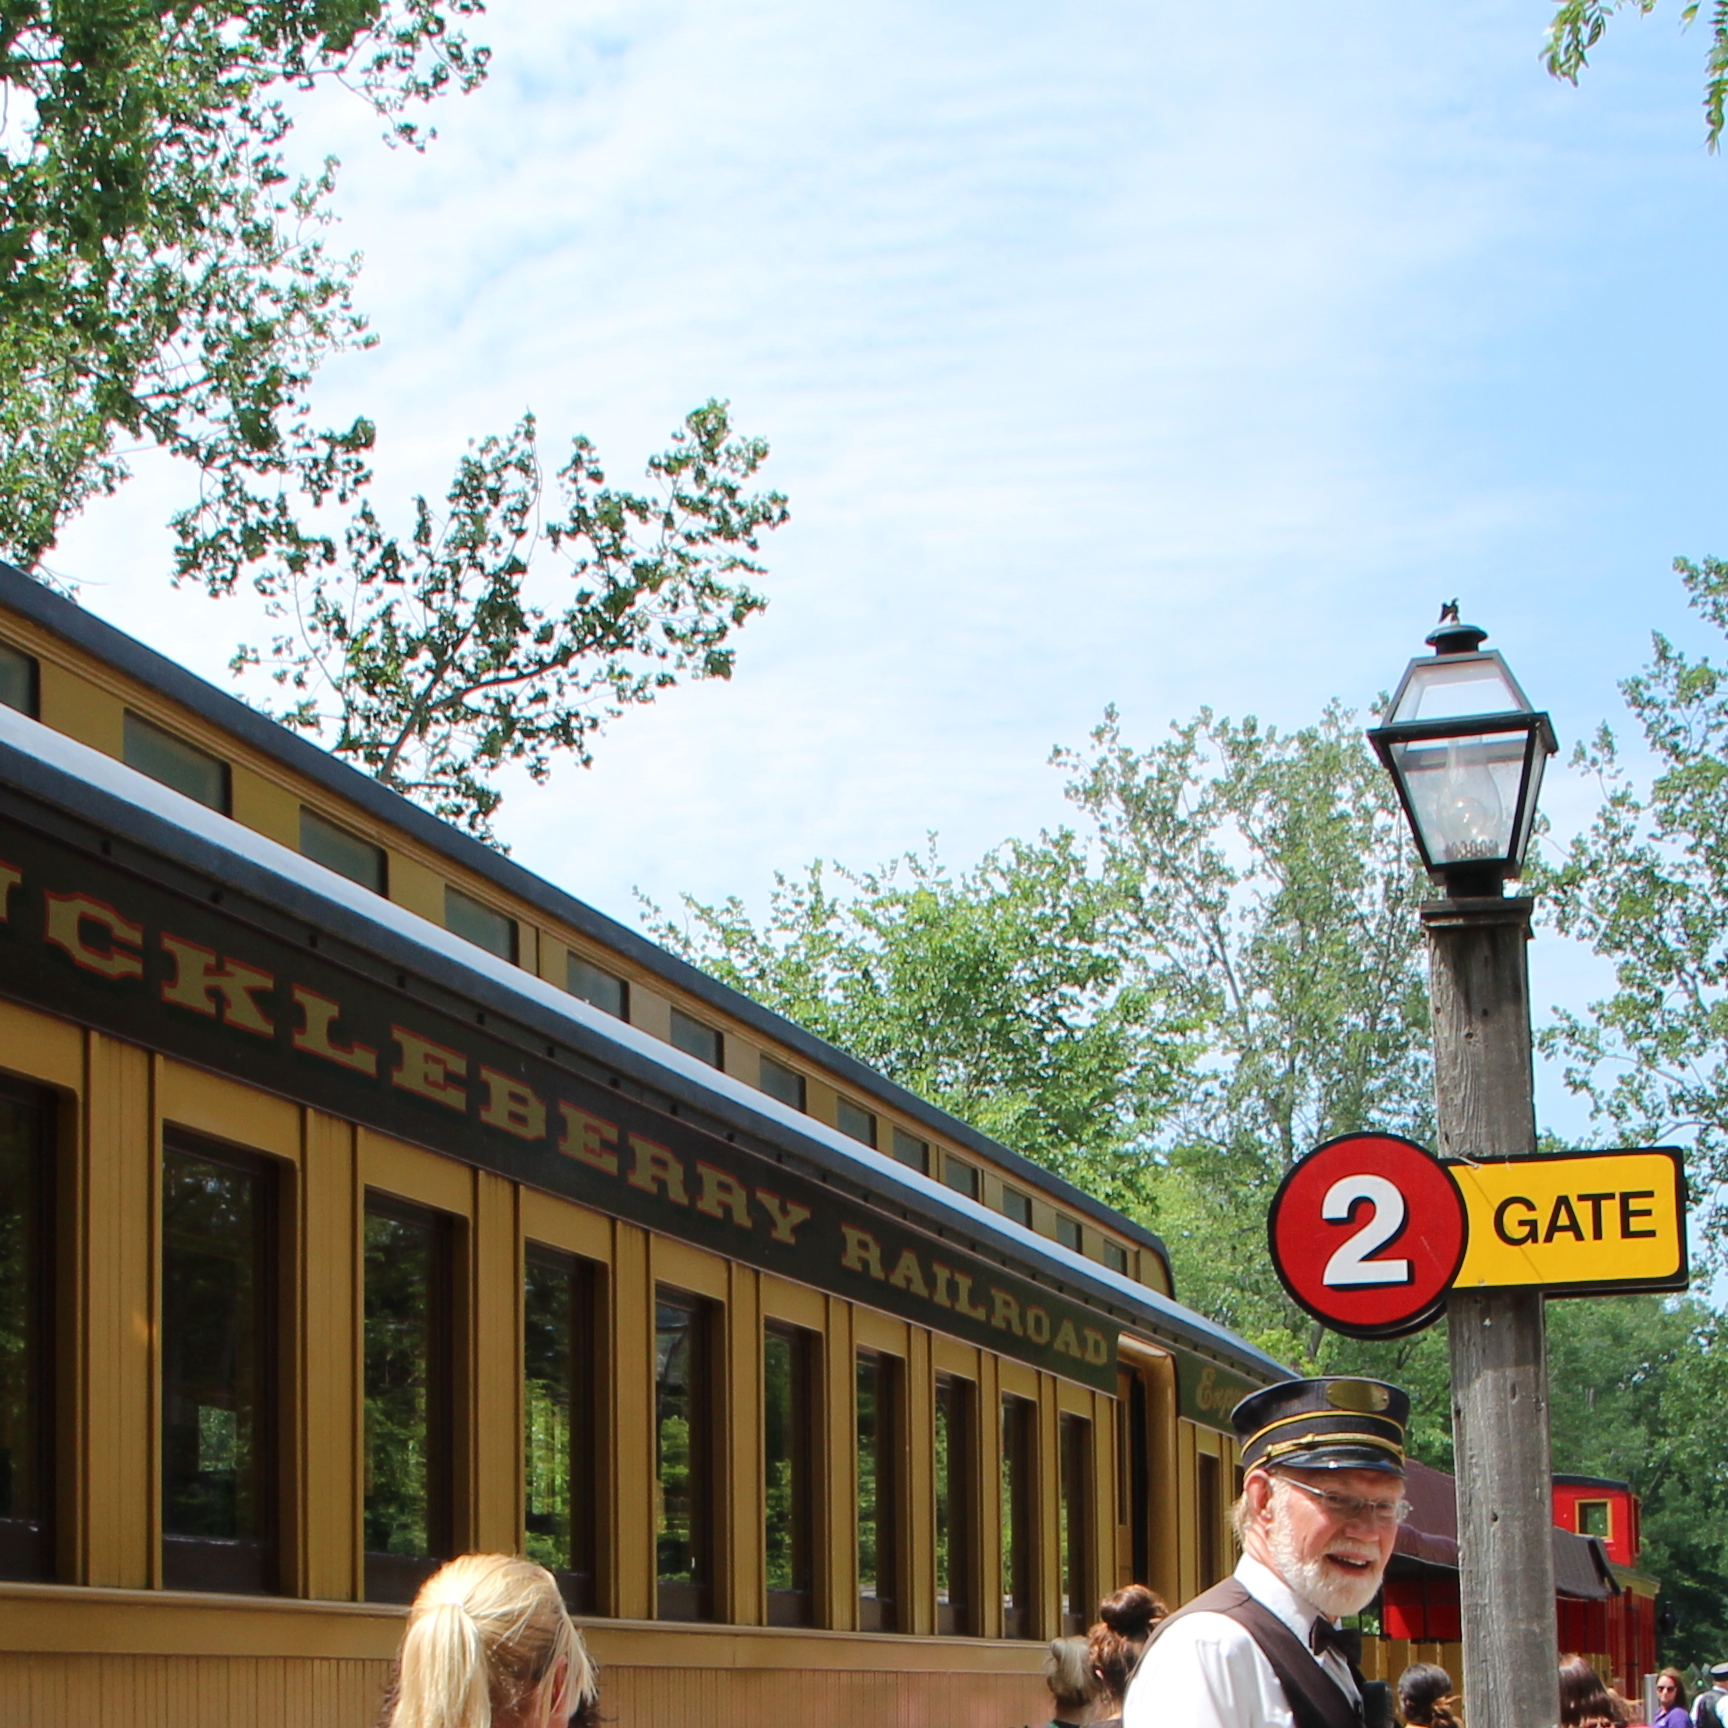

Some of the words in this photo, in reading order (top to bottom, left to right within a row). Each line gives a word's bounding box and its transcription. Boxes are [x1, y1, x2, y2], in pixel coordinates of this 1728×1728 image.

[840, 1222, 1108, 1367] RAILROAD
[1320, 1174, 1413, 1290] 2
[1493, 1189, 1657, 1246] GATE
